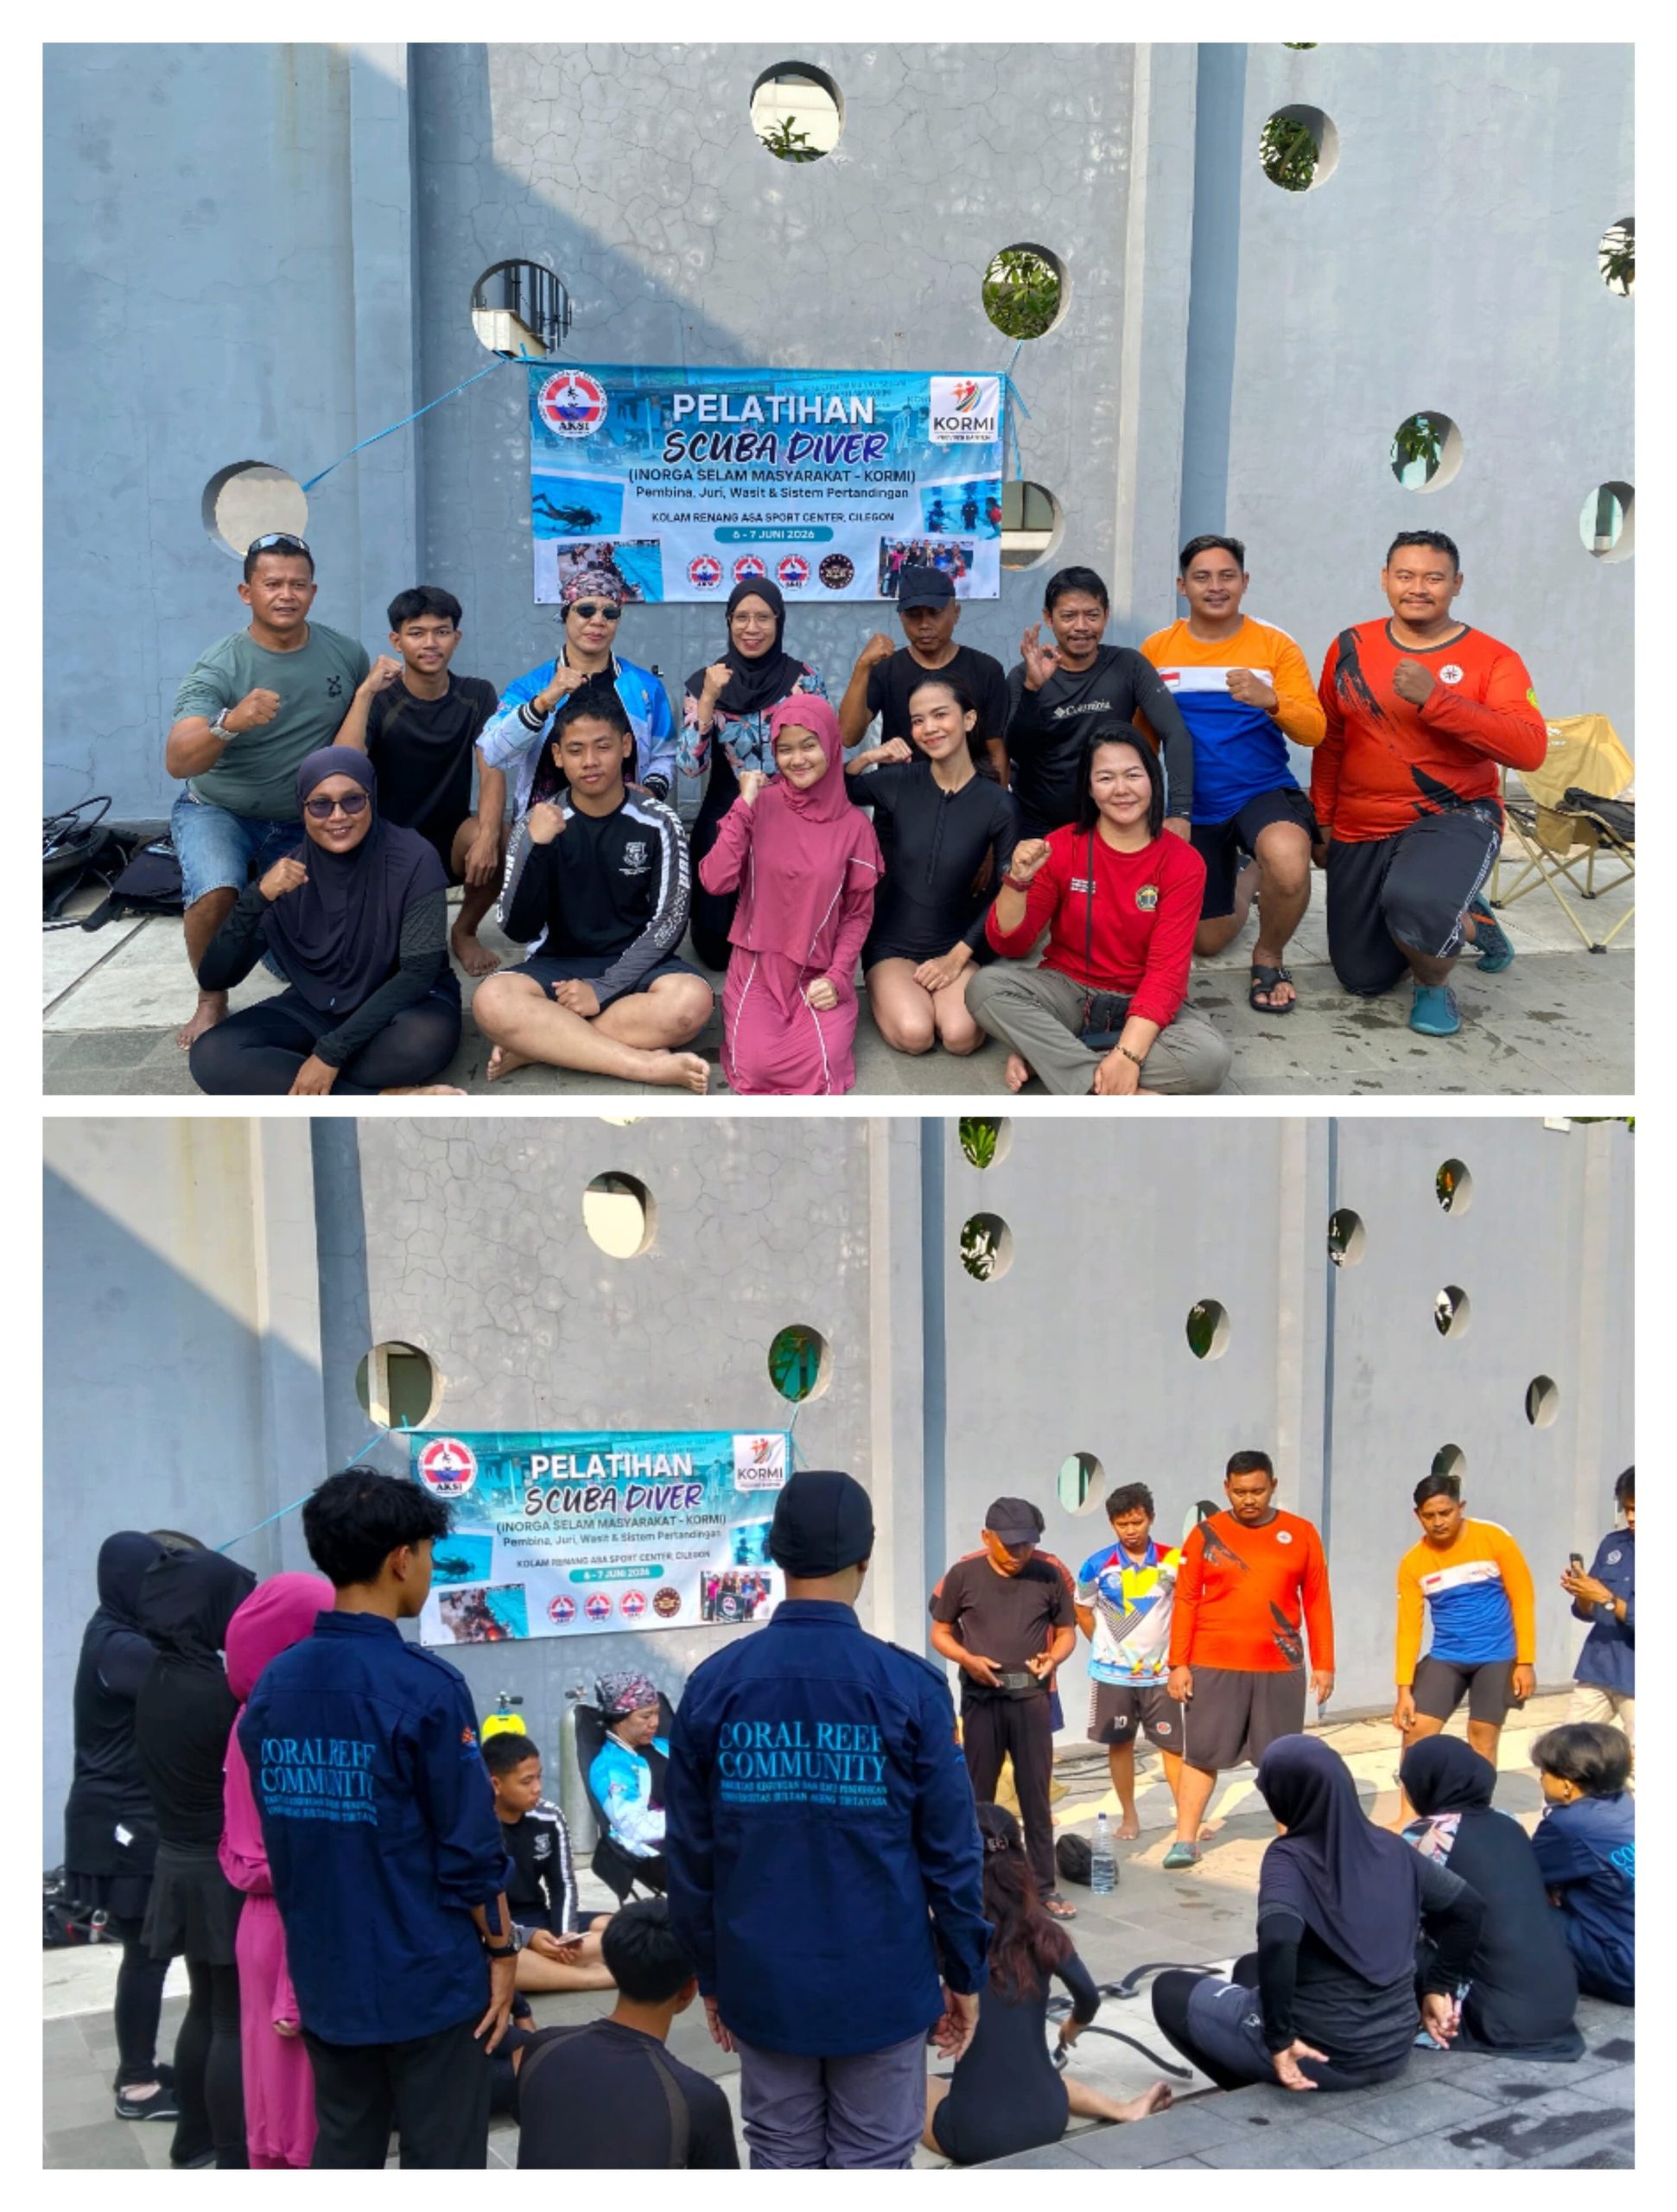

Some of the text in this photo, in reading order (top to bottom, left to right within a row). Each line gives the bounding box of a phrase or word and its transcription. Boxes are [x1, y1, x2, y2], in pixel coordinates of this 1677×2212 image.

[672, 394, 874, 424] PELATIHAN
[559, 422, 589, 431] AKSI
[934, 417, 994, 430] KORMI
[663, 431, 887, 465] SCUBA DIVER
[697, 469, 747, 481] SELAM
[752, 469, 852, 482] MASYARAKAT
[864, 470, 916, 483] KORMI)
[699, 487, 726, 499] Juri,
[730, 487, 765, 498] Wasit
[769, 487, 778, 498] &
[780, 487, 823, 498] Sistem
[827, 487, 908, 499] Pertandingan
[651, 513, 691, 523] KOLAM
[693, 513, 738, 523] RENANG
[741, 513, 762, 523] ASA
[765, 512, 800, 523] SPORT
[848, 512, 894, 522] CILEGON
[750, 531, 757, 539] 7
[759, 531, 785, 540] JUNI
[787, 530, 815, 539] 2026
[530, 1453, 693, 1479] PELATIHAN
[737, 1467, 783, 1480] KORMI
[436, 1482, 462, 1491] AKSI
[524, 1484, 703, 1516] SCUBA DIVER
[553, 1519, 595, 1531] SELAM
[598, 1516, 677, 1529] MASYARAKAT
[517, 1560, 549, 1568] KOLAM
[719, 1721, 882, 1752] CORAL REEF
[261, 1738, 327, 1764] CORAL
[719, 1751, 887, 1783] COMMUNITY
[1610, 1841, 1635, 1866] CO
